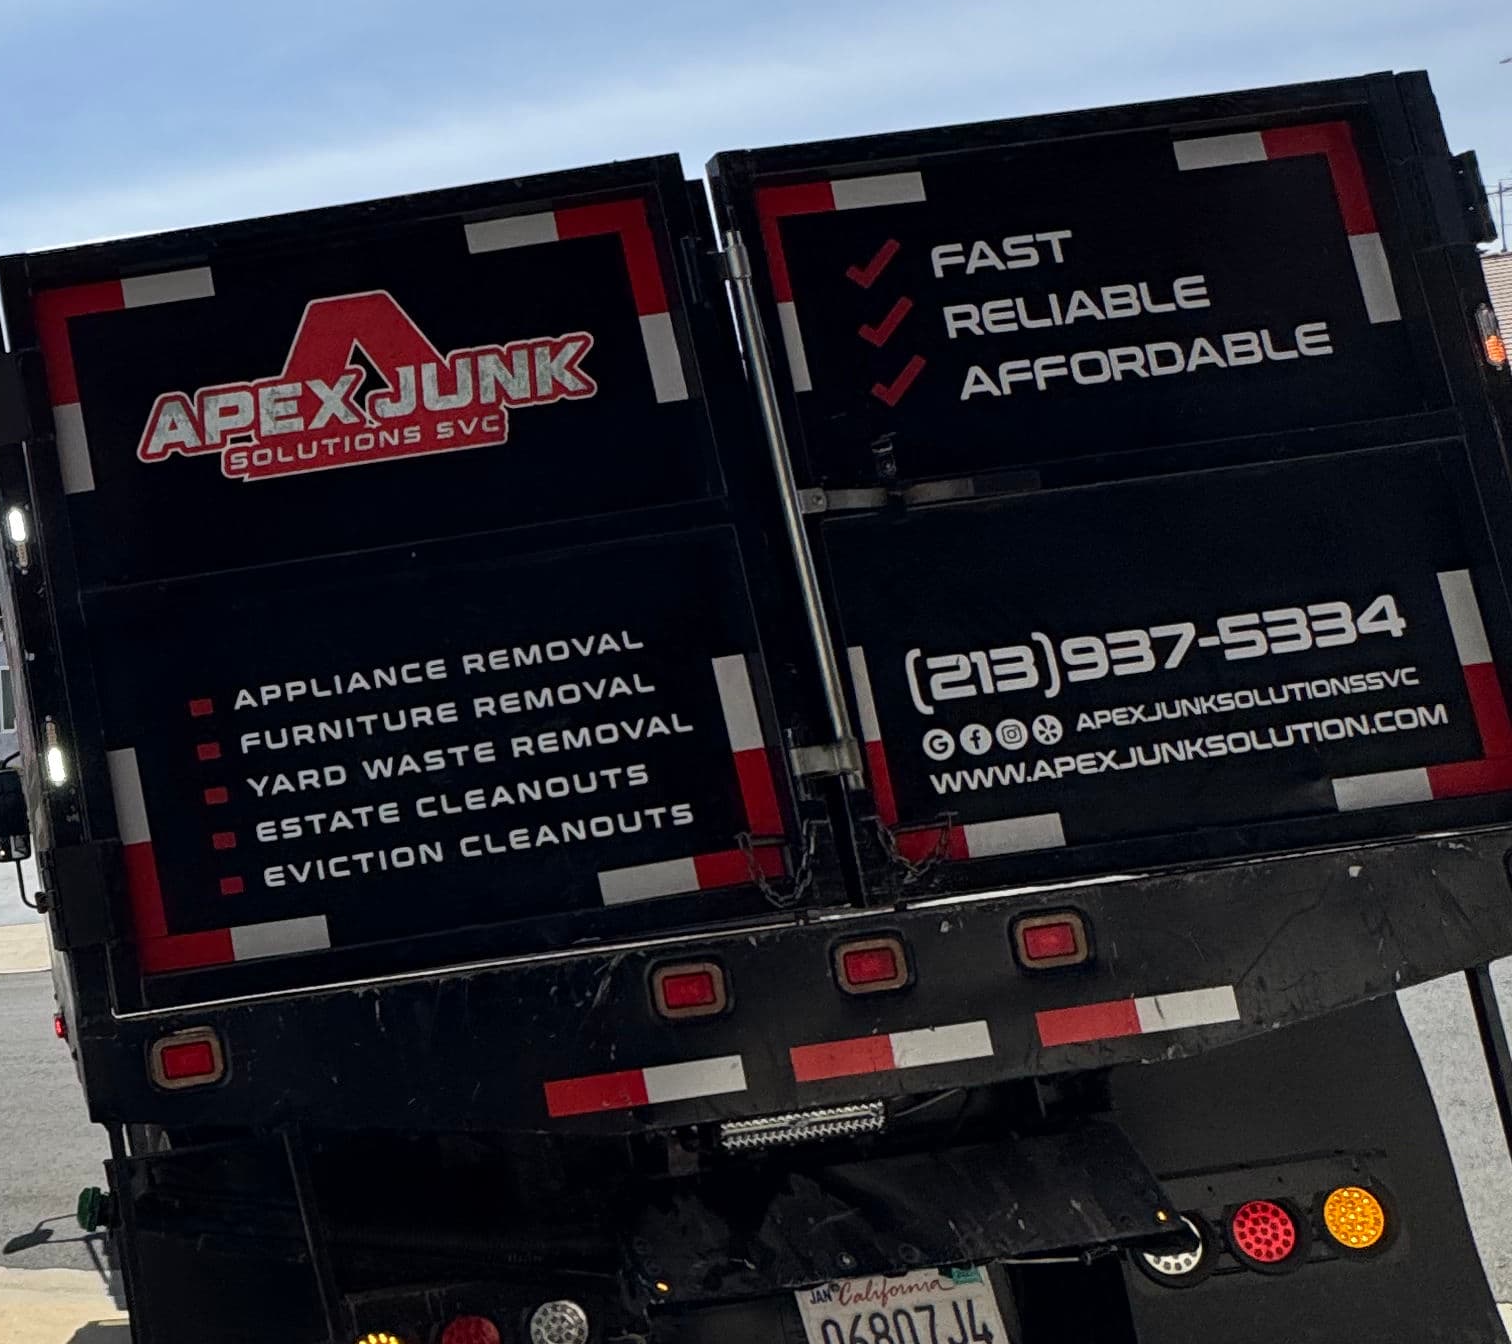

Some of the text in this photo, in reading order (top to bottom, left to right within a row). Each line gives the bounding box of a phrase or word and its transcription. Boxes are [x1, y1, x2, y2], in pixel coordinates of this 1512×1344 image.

[930, 229, 1073, 278] FAST
[942, 274, 1211, 339] RELIABLE
[145, 340, 588, 455] APEX JUNK
[959, 321, 1334, 401] AFFORDABLE
[230, 414, 501, 471] SOLUTIONS SVC
[233, 629, 644, 711] APPLIANCE REMOVAL
[904, 593, 1408, 716] (213)937-5334
[240, 672, 656, 755] FURNITURE REMOVAL
[1074, 665, 1420, 733] APEXJUNKSOLUTIONSSVC
[245, 712, 694, 798] YARD WASTE REMOVAL
[929, 702, 1449, 796] WWW.APEXJUNKSOLUTION.COM
[255, 763, 650, 843] ESTATE CLEANOUTS
[262, 802, 695, 888] EVICTION CLEANOUTS
[809, 1288, 833, 1305] JAN
[838, 1277, 954, 1308] California
